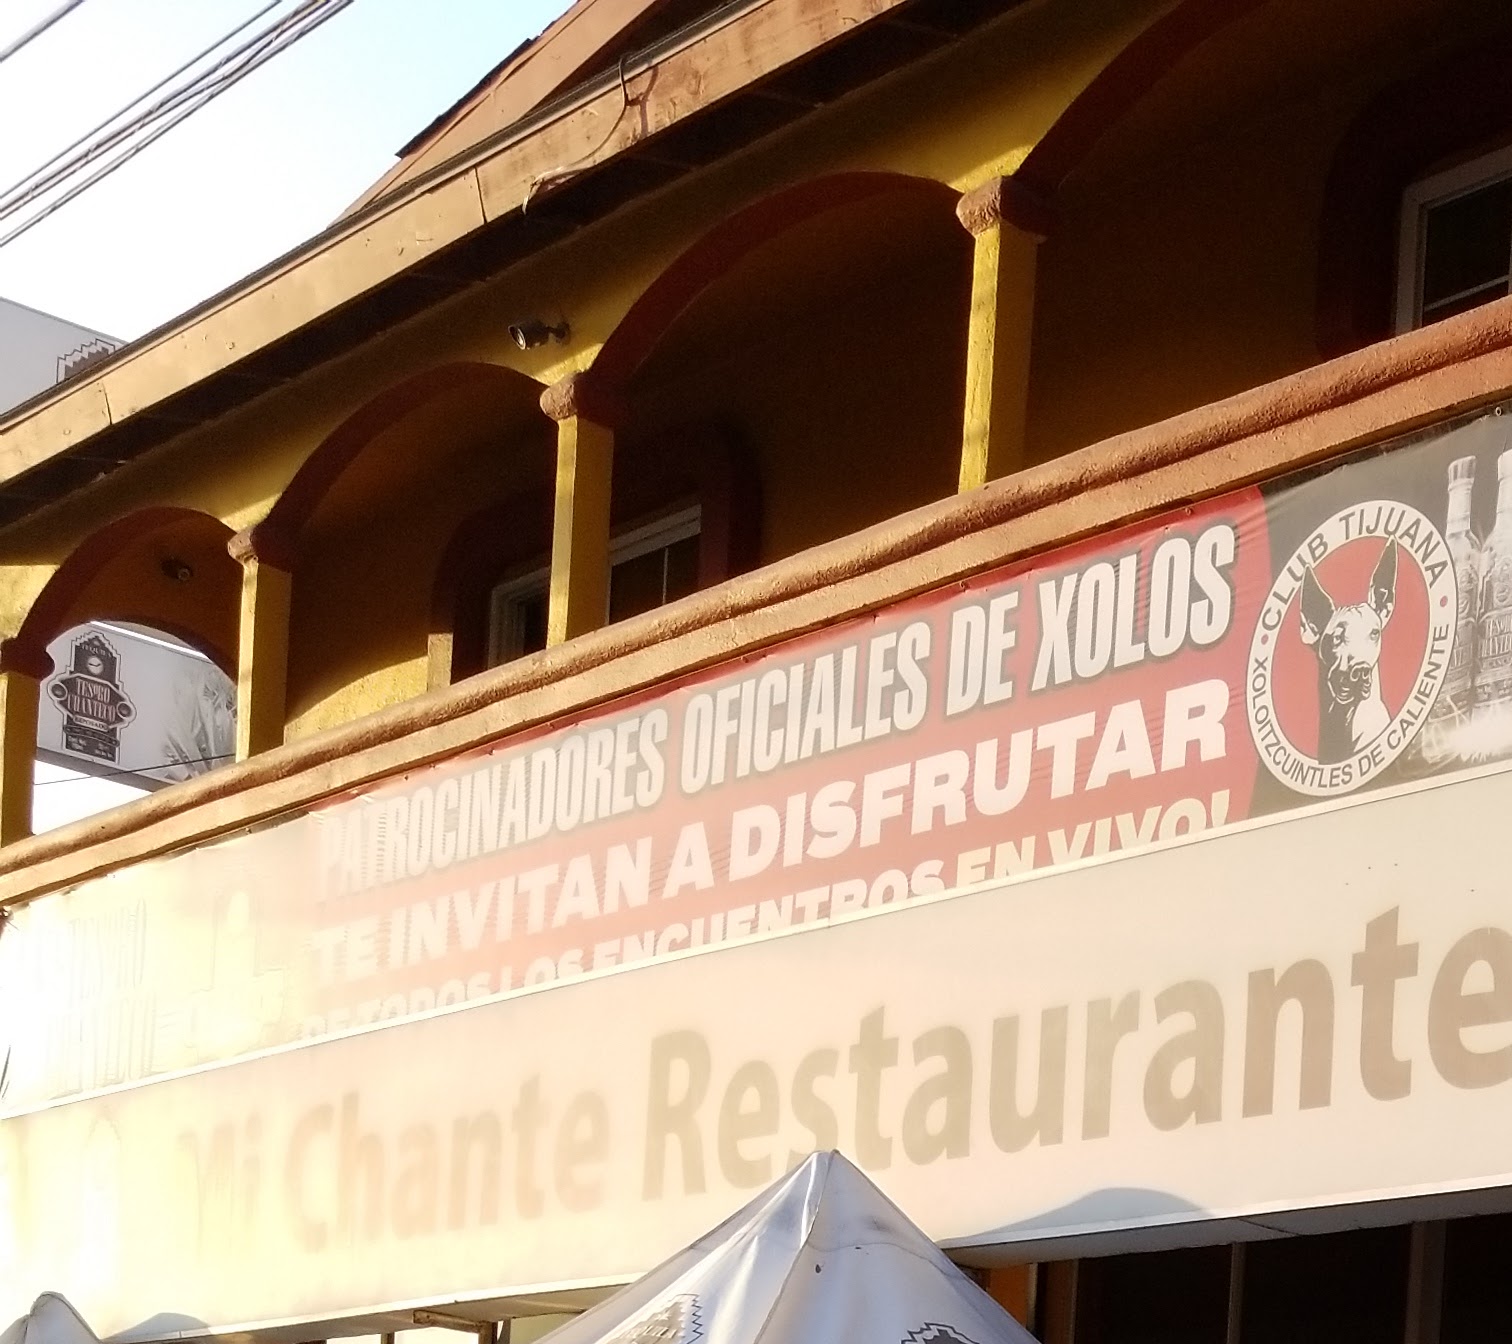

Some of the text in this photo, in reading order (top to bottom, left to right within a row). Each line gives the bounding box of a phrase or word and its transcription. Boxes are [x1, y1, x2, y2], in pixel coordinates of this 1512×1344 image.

[1262, 531, 1330, 631] CLUB
[1339, 505, 1449, 589] TIJUANA
[319, 523, 1237, 897] PATROCINADORES OFICIALES DE XOLOS
[1252, 656, 1353, 789] XOLOITZCUINTLES
[1358, 750, 1386, 778] DE
[1387, 623, 1450, 750] CALIENTE
[403, 836, 654, 971] INVITAN
[662, 821, 715, 900] A
[728, 678, 1231, 882] DISFRUTAR
[285, 1070, 611, 1252] Chante
